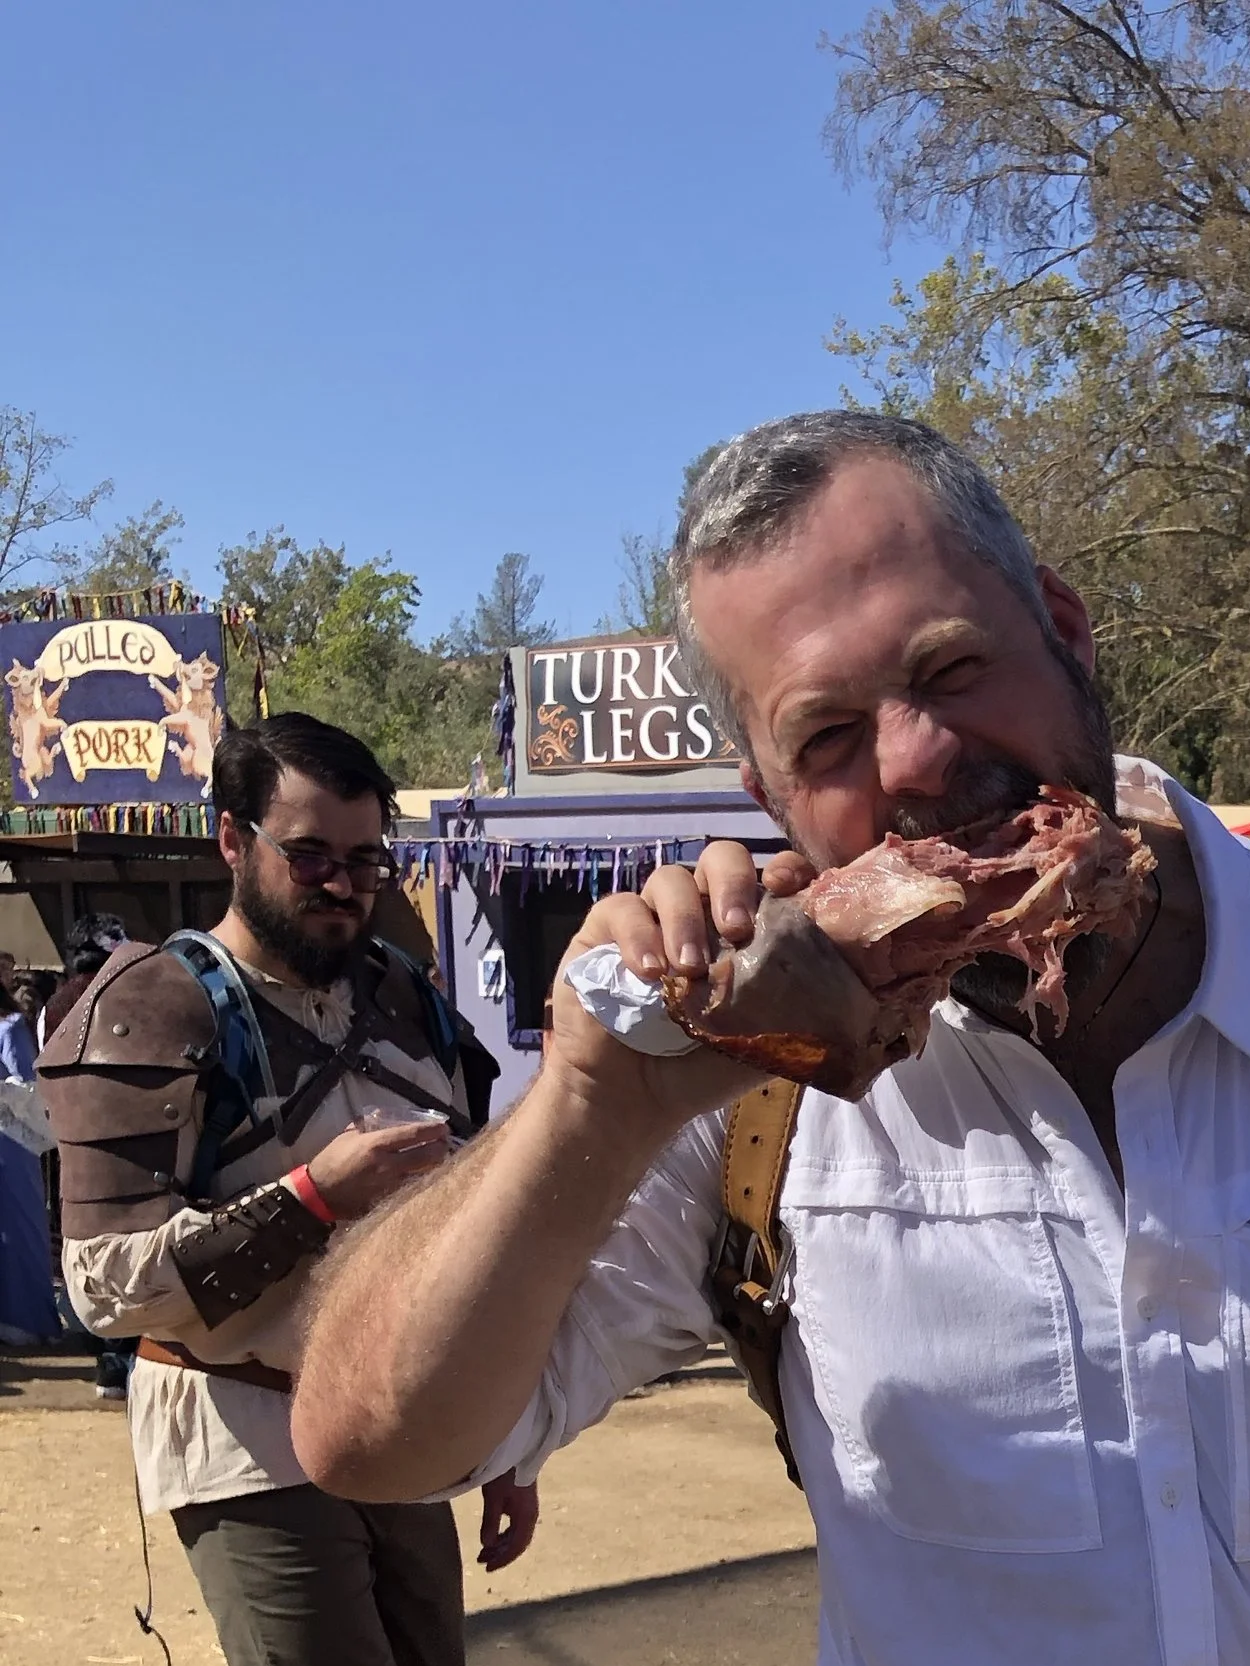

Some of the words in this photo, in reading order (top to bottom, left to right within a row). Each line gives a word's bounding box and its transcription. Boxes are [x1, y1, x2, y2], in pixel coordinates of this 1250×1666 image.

[532, 644, 698, 706] TURK
[72, 726, 156, 768] PORK
[579, 703, 713, 764] LEGS
